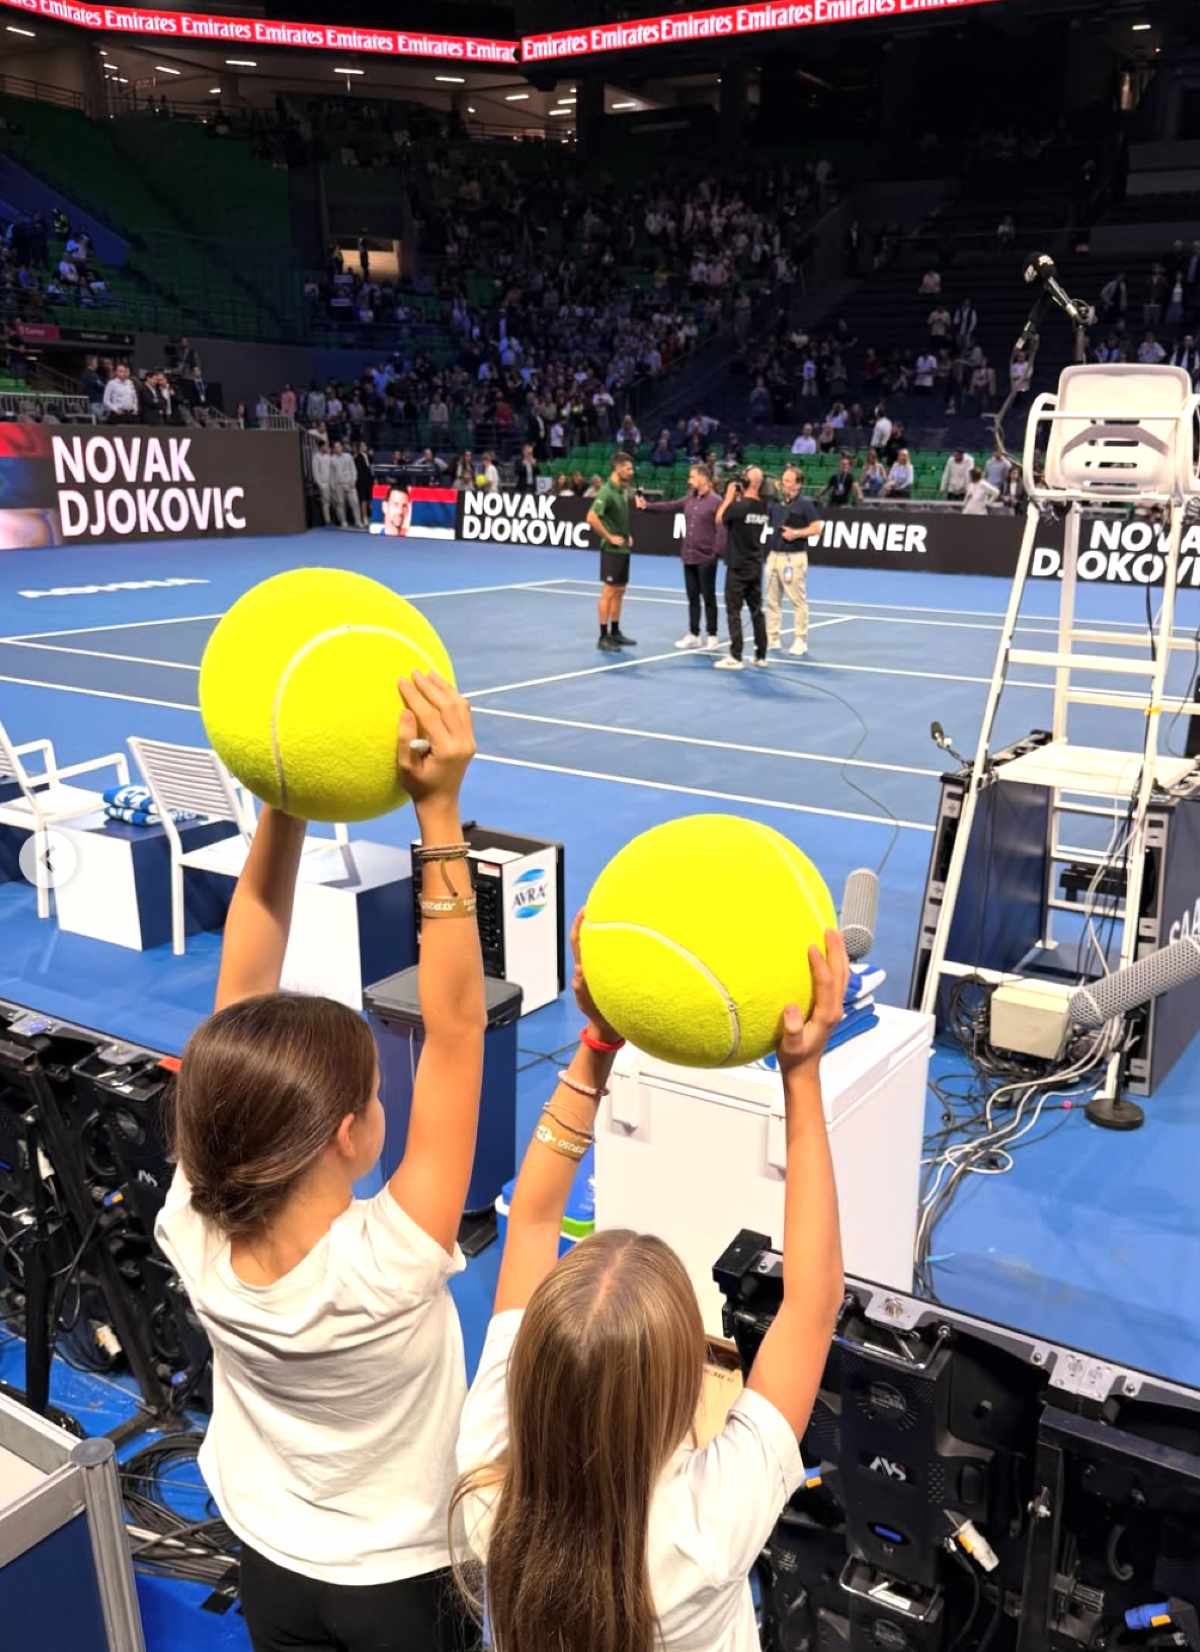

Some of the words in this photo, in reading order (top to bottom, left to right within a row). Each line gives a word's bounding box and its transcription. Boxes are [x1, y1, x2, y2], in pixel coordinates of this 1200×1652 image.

[40, 0, 101, 25] Emirates
[105, 10, 177, 32] Emirates
[181, 17, 252, 39] Emirates
[255, 24, 323, 44] Emirates
[326, 30, 393, 50] Emirates
[397, 36, 463, 57] Emirates
[522, 36, 588, 59] Emirates
[591, 26, 659, 49] Emirates
[660, 16, 733, 40] Emirates
[736, 5, 813, 31] Emirates
[815, 0, 895, 20] Emirates
[51, 436, 195, 483] NOVAK
[58, 486, 247, 536] DJOKOVIC
[464, 491, 557, 520] NOVAK
[462, 516, 591, 547] DJOKOVIC
